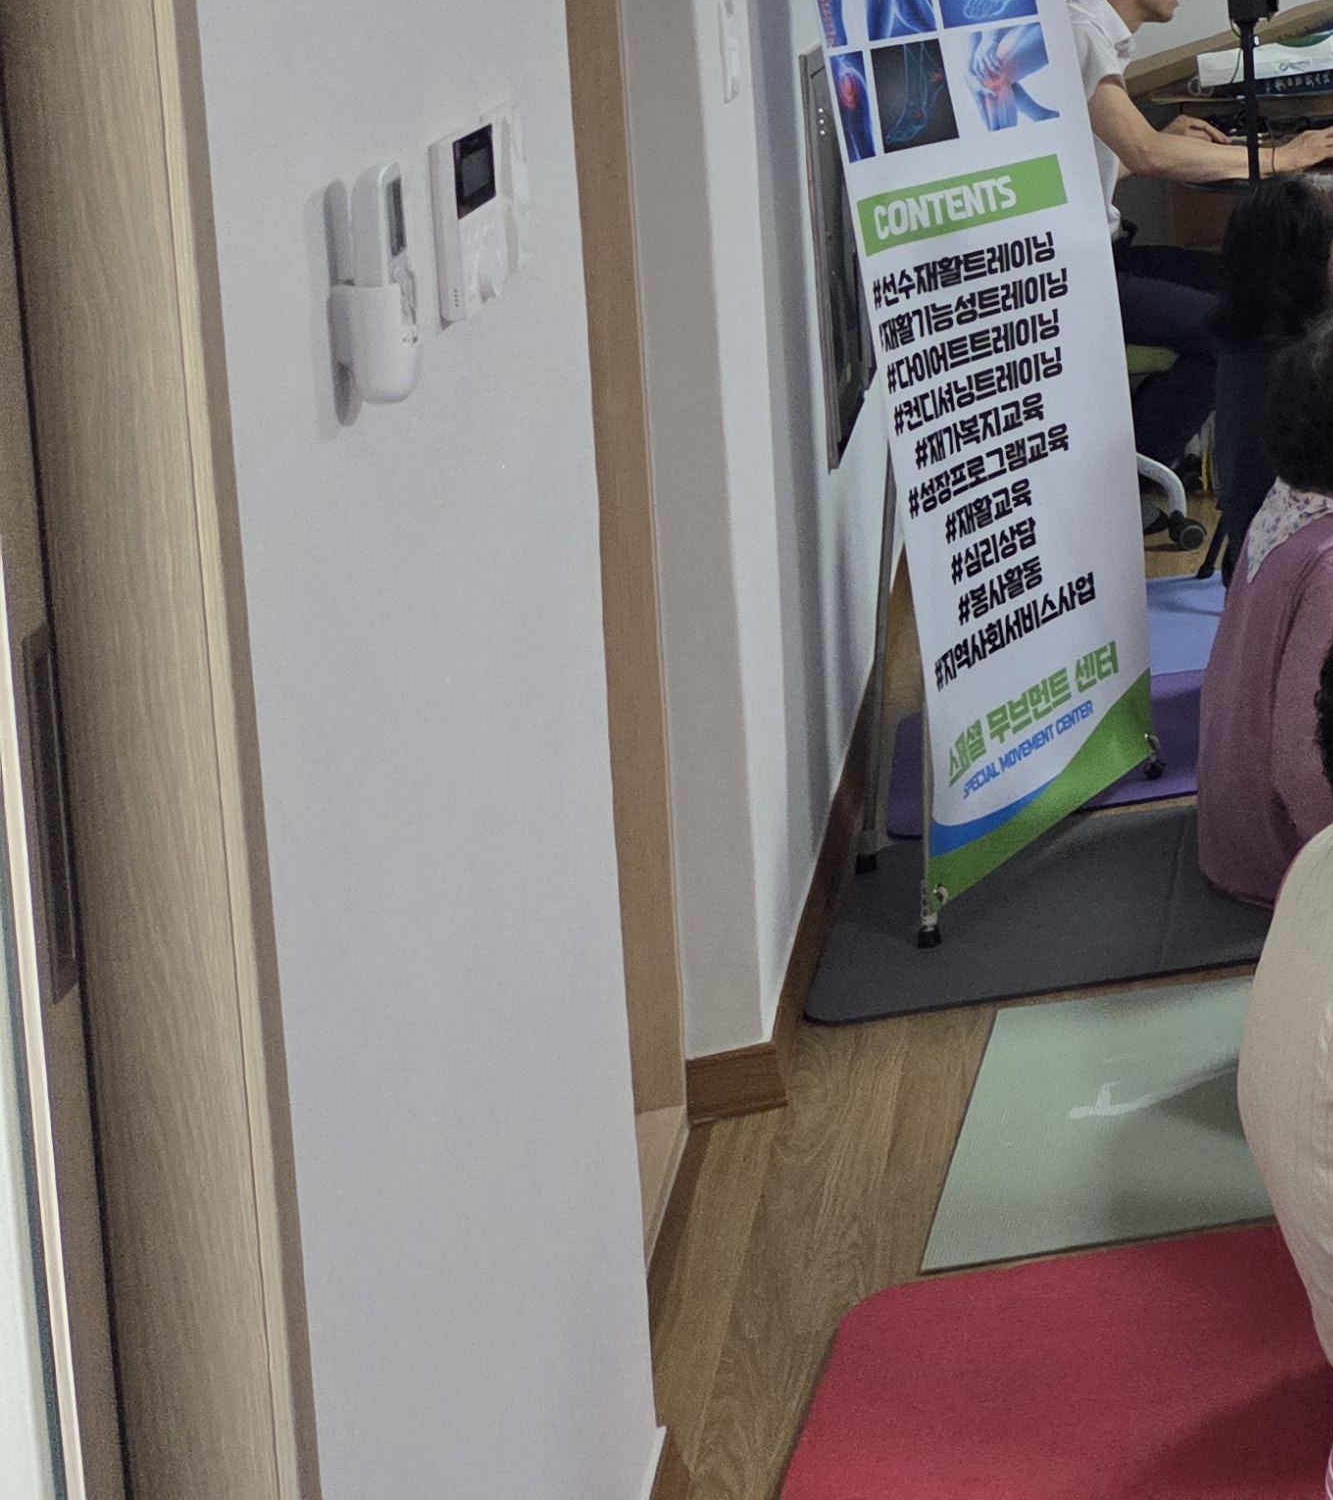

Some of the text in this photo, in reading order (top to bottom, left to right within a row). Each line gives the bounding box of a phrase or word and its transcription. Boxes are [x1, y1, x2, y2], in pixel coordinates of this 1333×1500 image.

[873, 175, 1017, 240] CONTENTS
[873, 231, 1056, 311] #선수재활트레이닝
[887, 308, 1060, 394] #다이어트트레이닝
[894, 346, 1063, 436] #컨디셔닝트레이닝
[908, 423, 1069, 519] #성장프로그램교육
[915, 392, 1044, 470] #재가복지교육
[945, 478, 1032, 544] #재활교육
[951, 516, 1036, 585] #심리상담
[934, 571, 1096, 692] #지역사회서비스사업
[958, 556, 1043, 626] #봉사활동
[985, 666, 1073, 744] 무브먼트
[1074, 639, 1119, 694] 센터
[963, 699, 1094, 799] SPECIAL MOVEMENT CENTER
